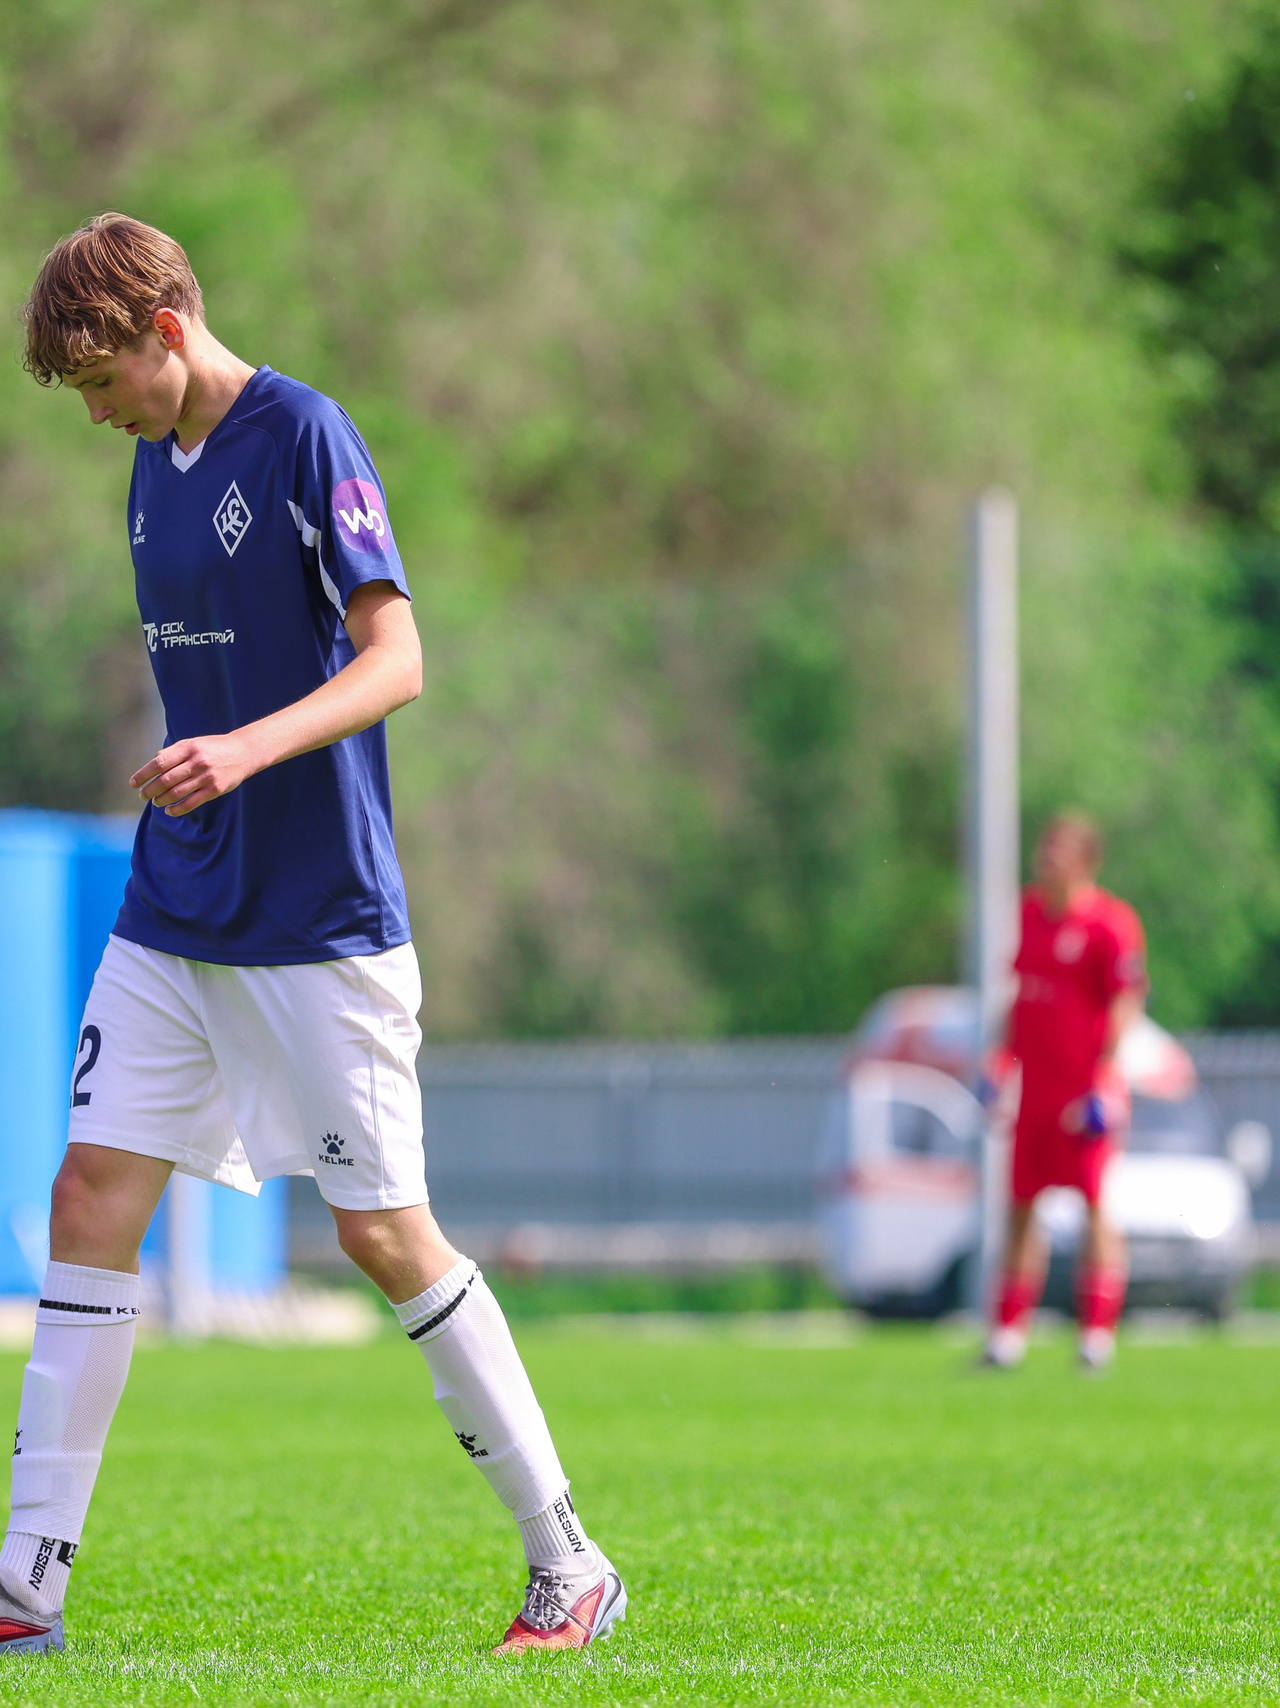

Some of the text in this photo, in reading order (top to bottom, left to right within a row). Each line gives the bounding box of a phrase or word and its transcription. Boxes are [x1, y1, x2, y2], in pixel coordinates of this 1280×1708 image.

[160, 621, 186, 636] ДСК
[160, 629, 235, 649] ТРАНССТРОЙ
[318, 1153, 355, 1166] KELME
[553, 1501, 586, 1553] DESIGN
